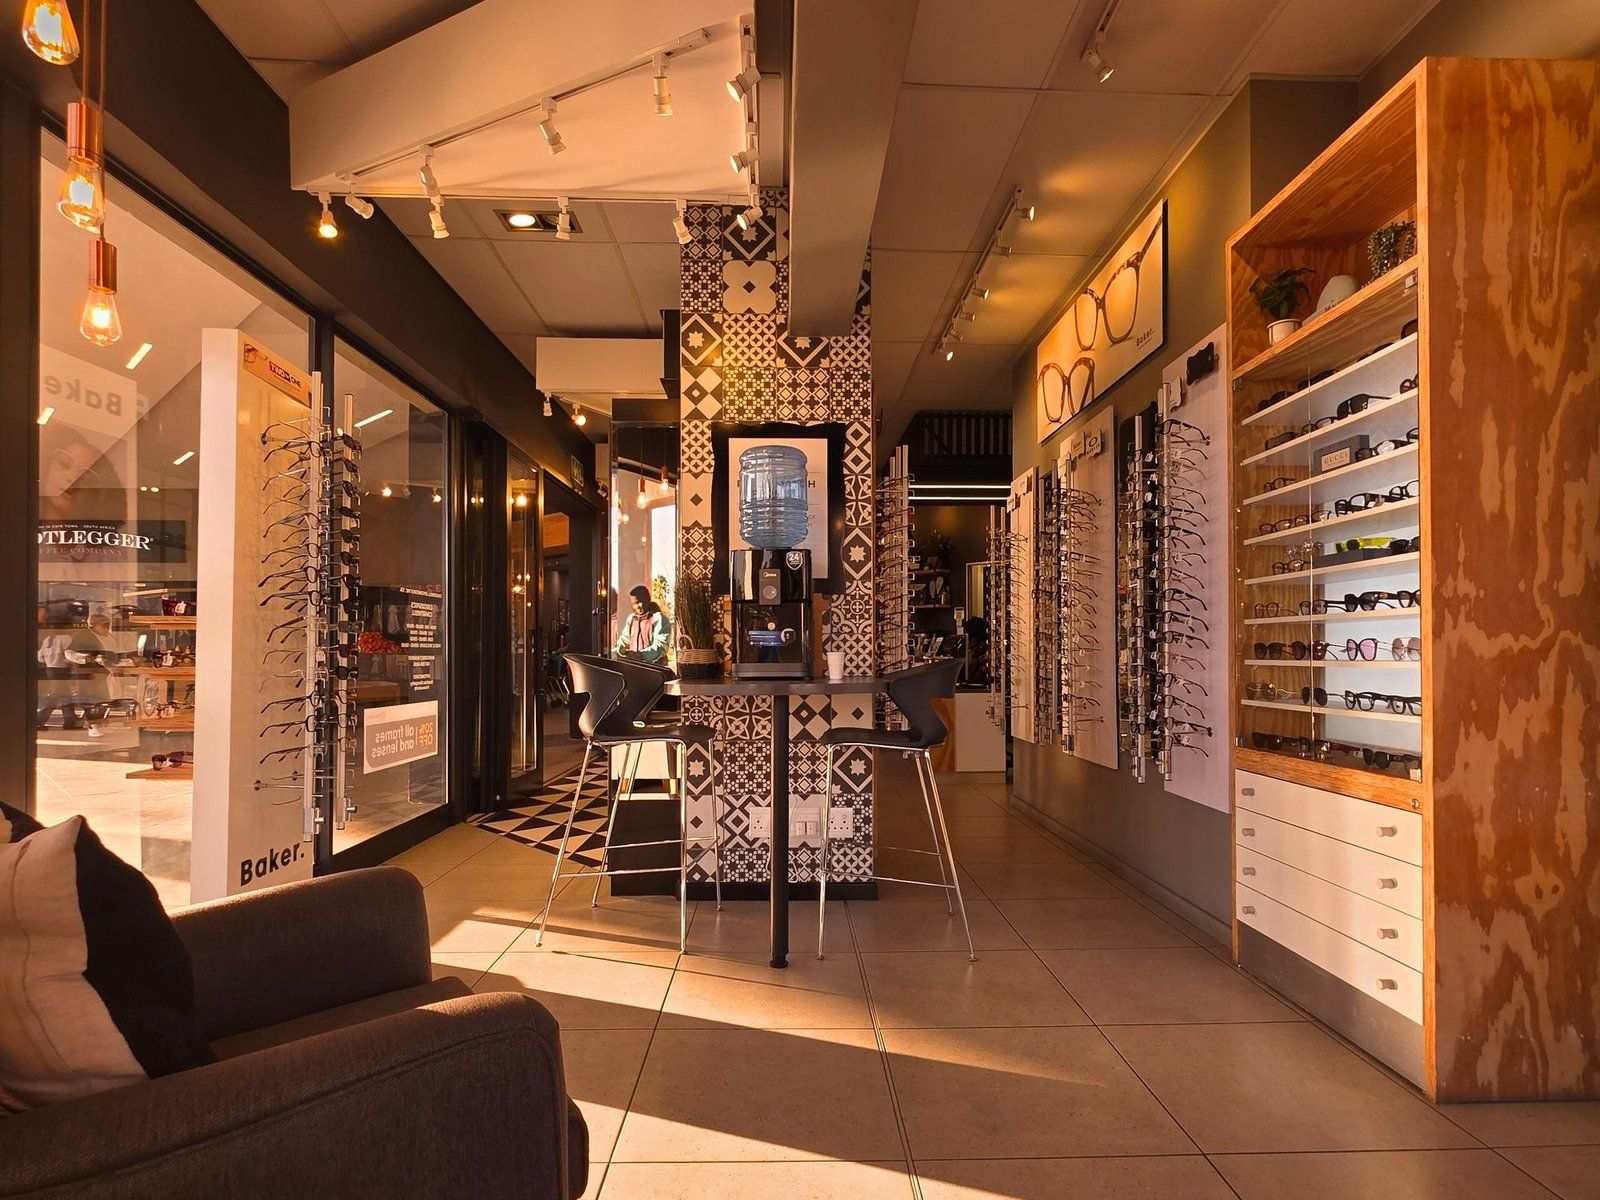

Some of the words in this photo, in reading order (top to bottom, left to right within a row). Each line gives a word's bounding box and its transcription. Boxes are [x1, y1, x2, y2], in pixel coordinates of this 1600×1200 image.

[1324, 451, 1348, 464] GUCCI
[788, 553, 800, 561] 24
[240, 843, 305, 887] Baker.
